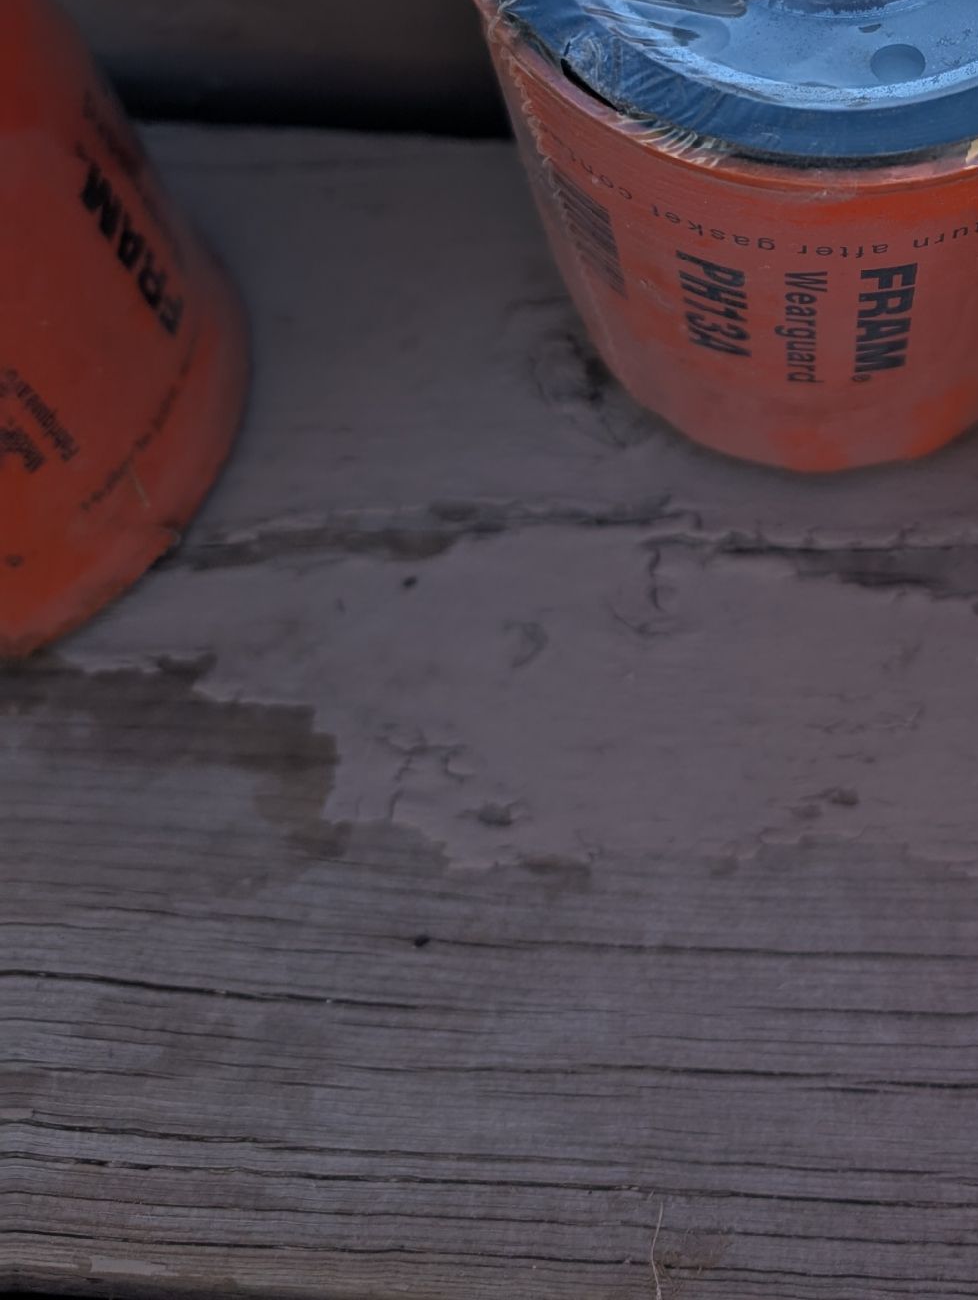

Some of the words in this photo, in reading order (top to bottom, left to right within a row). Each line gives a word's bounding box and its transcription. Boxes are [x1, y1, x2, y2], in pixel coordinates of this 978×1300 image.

[651, 204, 776, 251] gasket
[797, 243, 889, 259] after
[676, 250, 752, 358] PH13A
[774, 271, 828, 384] Wearguard
